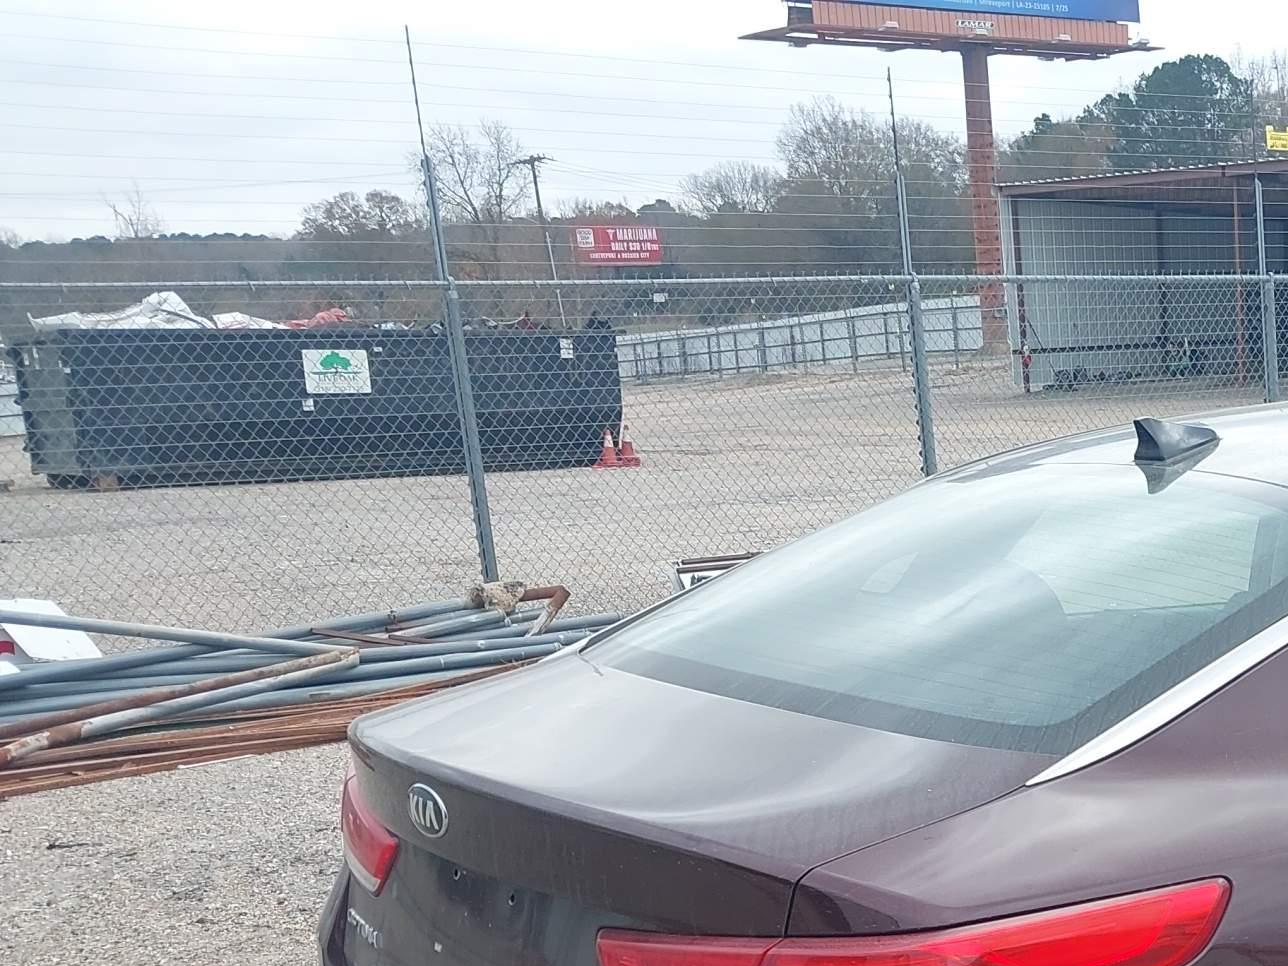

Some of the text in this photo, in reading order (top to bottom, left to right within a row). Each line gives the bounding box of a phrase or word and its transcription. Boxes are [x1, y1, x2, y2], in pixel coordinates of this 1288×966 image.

[958, 20, 994, 29] LAMAR
[616, 227, 658, 241] MARIJUANA
[409, 792, 440, 831] KIA
